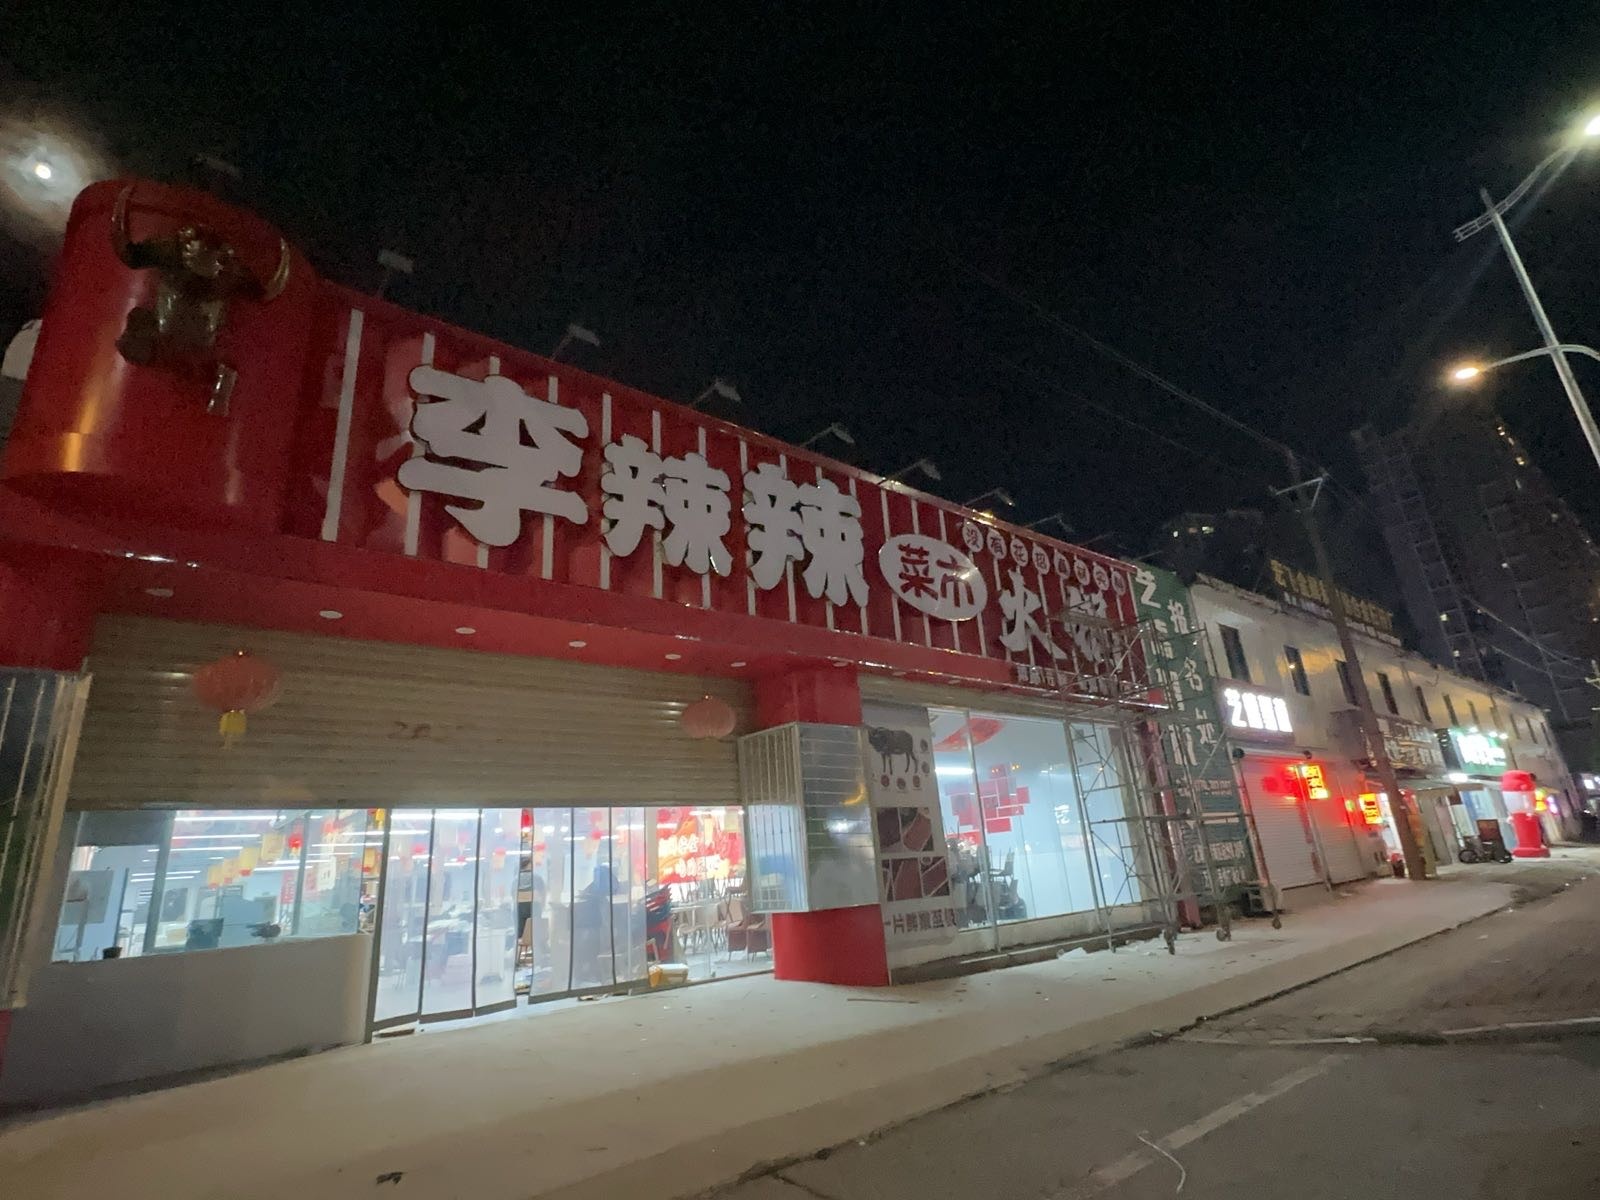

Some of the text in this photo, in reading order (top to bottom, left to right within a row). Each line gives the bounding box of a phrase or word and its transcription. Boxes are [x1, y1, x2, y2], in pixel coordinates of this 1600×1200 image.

[398, 364, 869, 607] 李辣辣
[897, 543, 976, 608] 菜市
